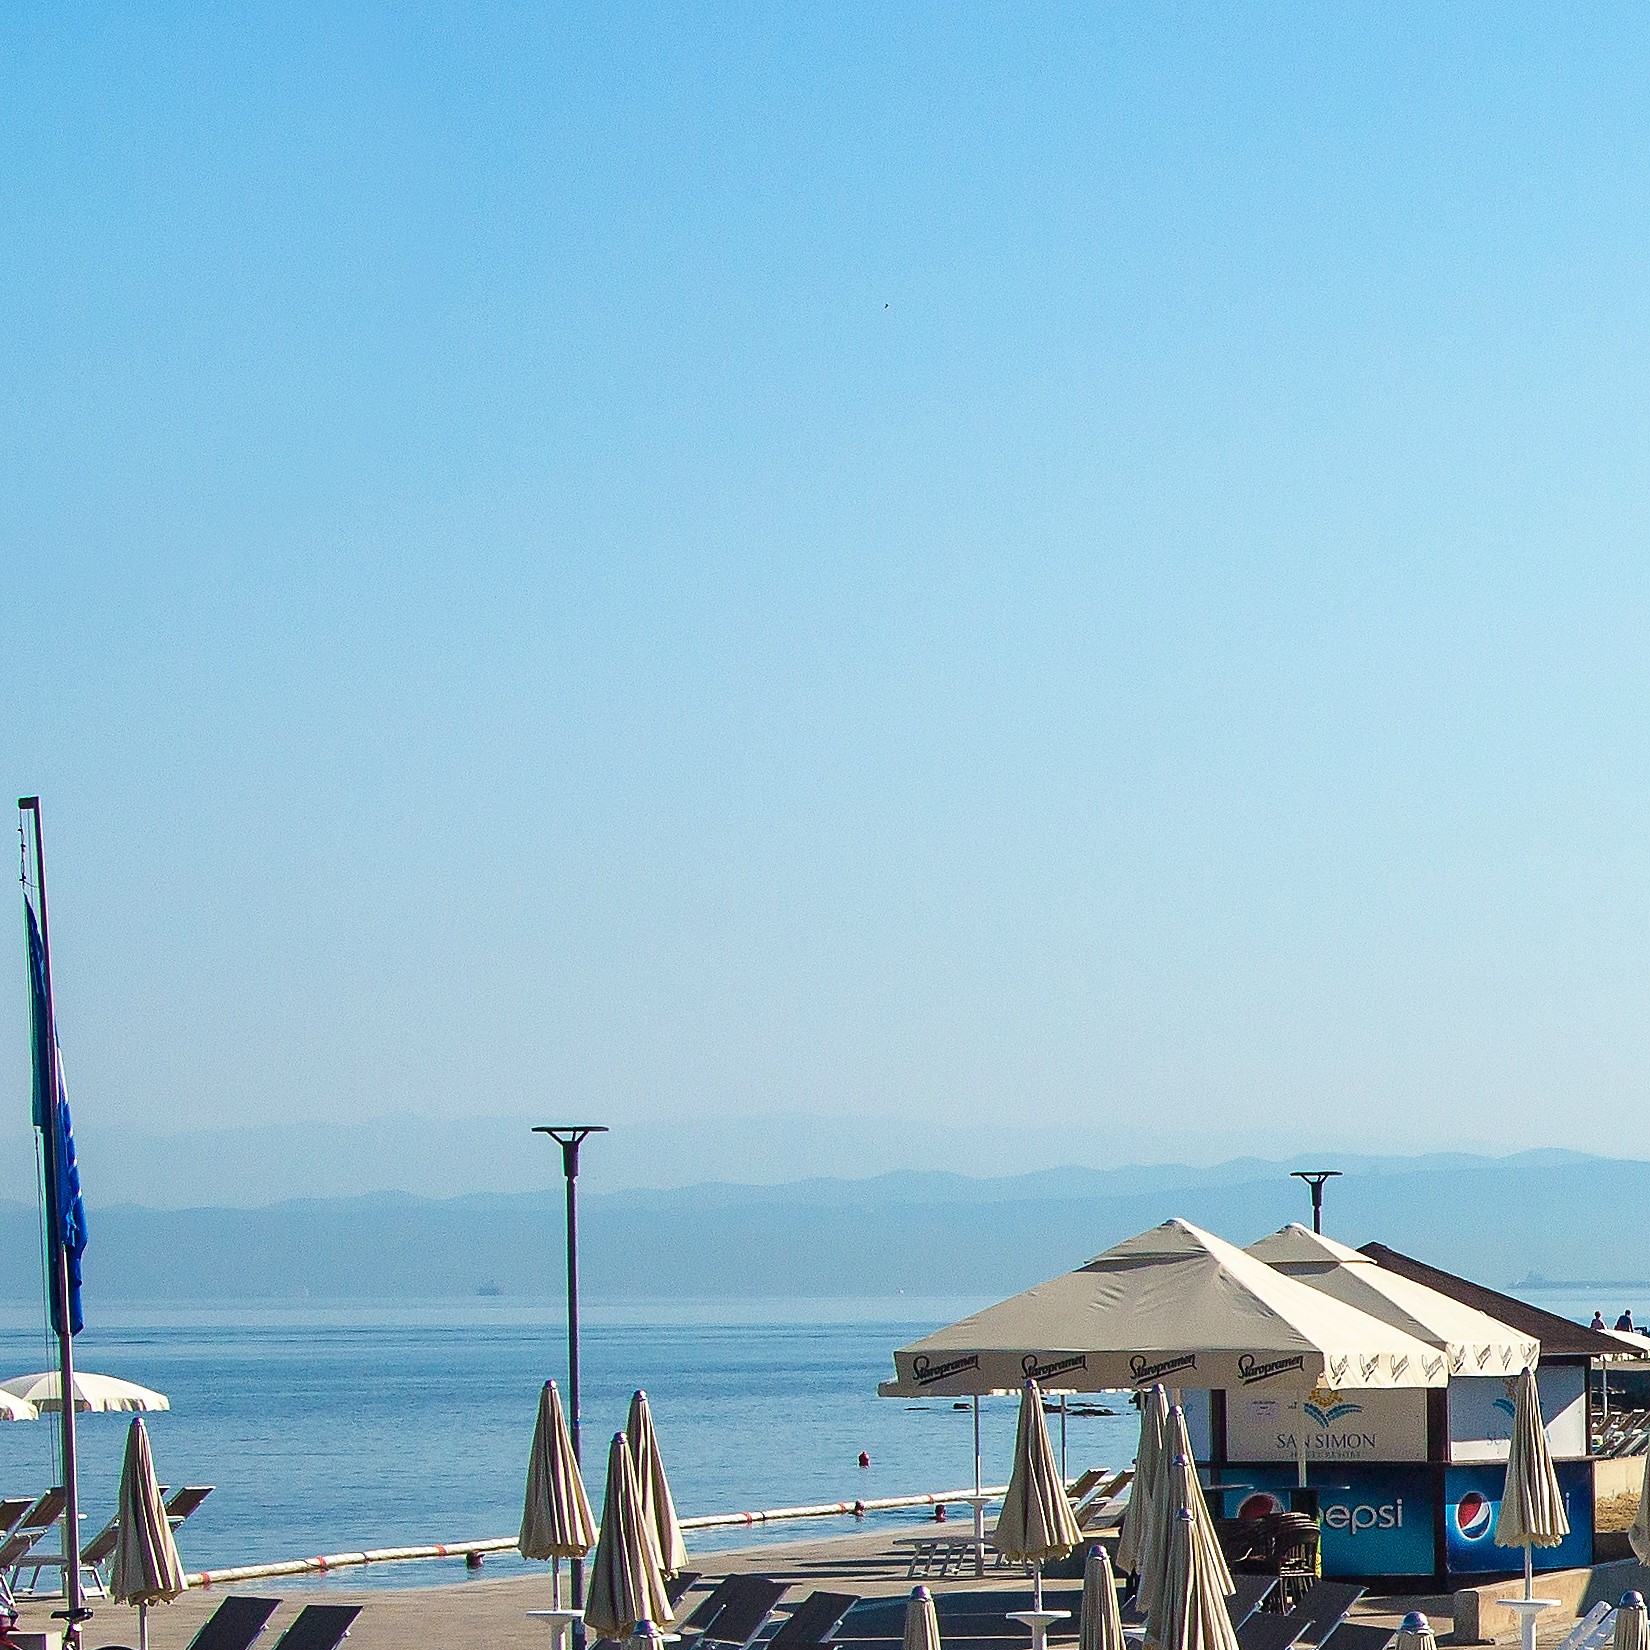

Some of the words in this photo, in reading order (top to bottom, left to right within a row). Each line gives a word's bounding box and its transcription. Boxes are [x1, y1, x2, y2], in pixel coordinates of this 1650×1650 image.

[913, 1355, 981, 1383] Staropramen
[1021, 1354, 1088, 1381] Staropramen
[1130, 1354, 1197, 1383] Staropramen
[1237, 1354, 1304, 1383] Staropramen
[1315, 1433, 1377, 1449] SIMON
[1319, 1498, 1403, 1535] epsi
